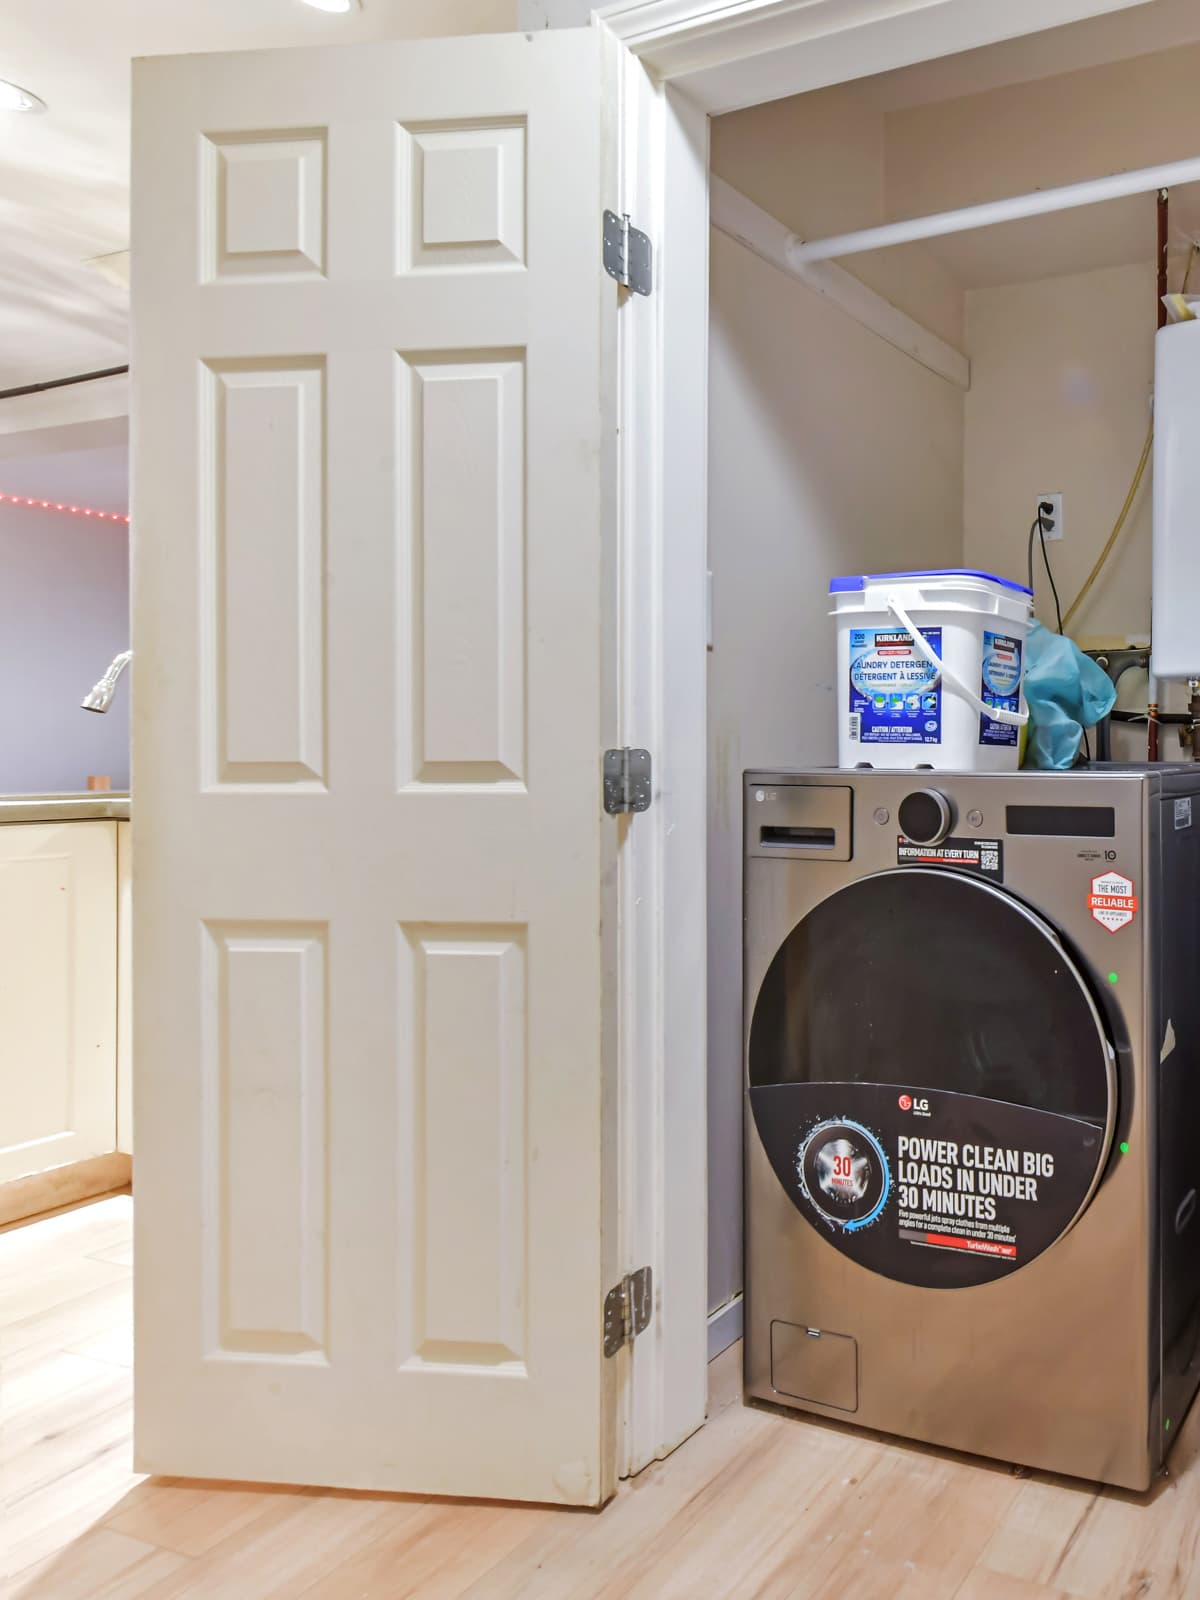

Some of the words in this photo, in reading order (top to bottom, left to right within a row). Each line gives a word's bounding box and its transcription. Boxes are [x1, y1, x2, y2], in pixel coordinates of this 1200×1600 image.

[876, 634, 914, 642] KIRKLAND
[890, 660, 937, 669] DETERGEN
[854, 671, 897, 680] DÉTERGENT
[900, 670, 905, 680] À
[907, 672, 936, 680] LESSIVE
[899, 847, 936, 857] INFORMATION
[937, 849, 944, 857] AT
[944, 849, 963, 858] EVERY
[963, 850, 979, 859] TURN
[1098, 884, 1109, 893] THE
[1110, 885, 1127, 894] MOST
[1091, 897, 1134, 908] RELIABLE
[913, 1098, 928, 1111] LG
[898, 1136, 958, 1165] POWER
[962, 1144, 1019, 1173] CLEAN
[1023, 1151, 1054, 1177] BIG
[833, 1155, 851, 1177] 30
[832, 1178, 853, 1187] MINUTES
[898, 1160, 952, 1189] LOADS
[957, 1168, 974, 1192] IN
[978, 1171, 1038, 1201] UNDER
[898, 1185, 919, 1209] 30
[922, 1188, 996, 1220] MINUTES
[899, 1209, 909, 1217] Five
[909, 1211, 931, 1221] powerful
[931, 1214, 941, 1223] jets
[942, 1217, 955, 1226] spray
[955, 1218, 974, 1227] clothes
[975, 1221, 988, 1230] from
[988, 1223, 1010, 1233] multiple
[899, 1219, 915, 1228] angles
[928, 1223, 951, 1233] complete
[952, 1225, 965, 1235] clean
[972, 1229, 986, 1238] under
